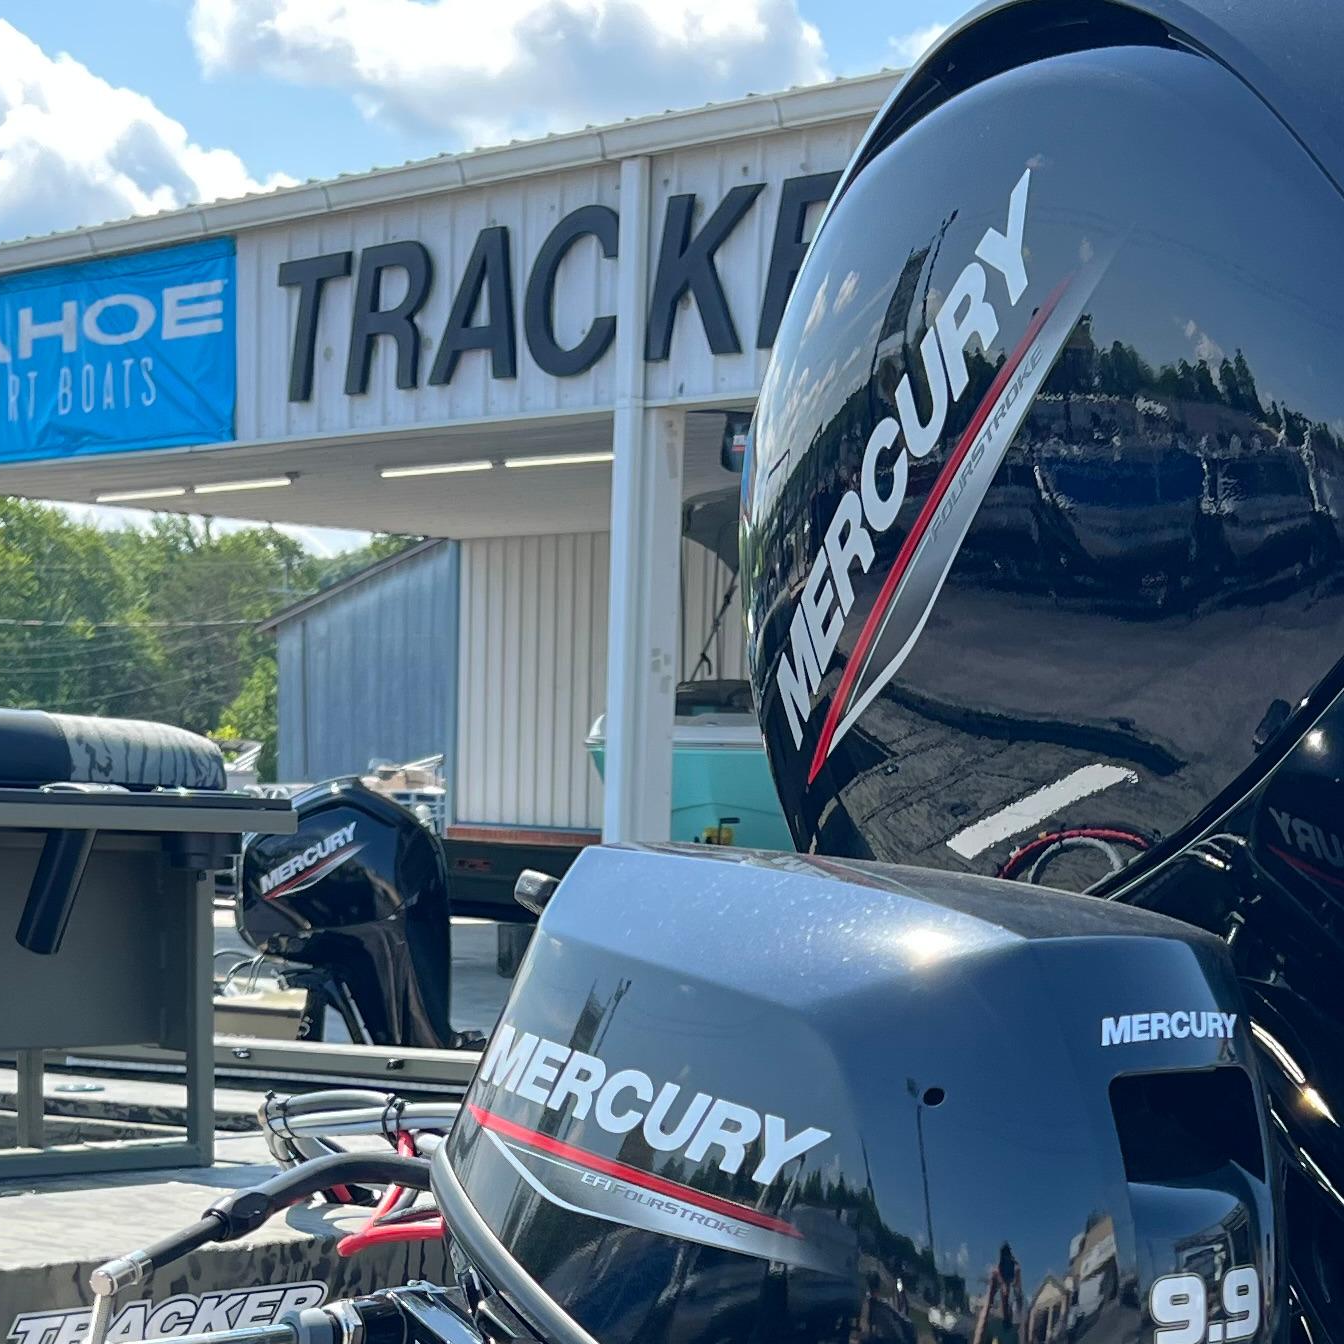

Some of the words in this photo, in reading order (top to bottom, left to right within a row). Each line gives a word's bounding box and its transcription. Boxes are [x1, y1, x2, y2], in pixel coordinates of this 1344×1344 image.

[57, 355, 158, 417] BOATS
[928, 343, 1044, 544] FOURSTROKE
[777, 166, 1031, 750] MERCURY
[259, 820, 358, 895] MERCURY
[1101, 1010, 1238, 1047] MERCURY
[479, 1023, 832, 1186] MERCURY
